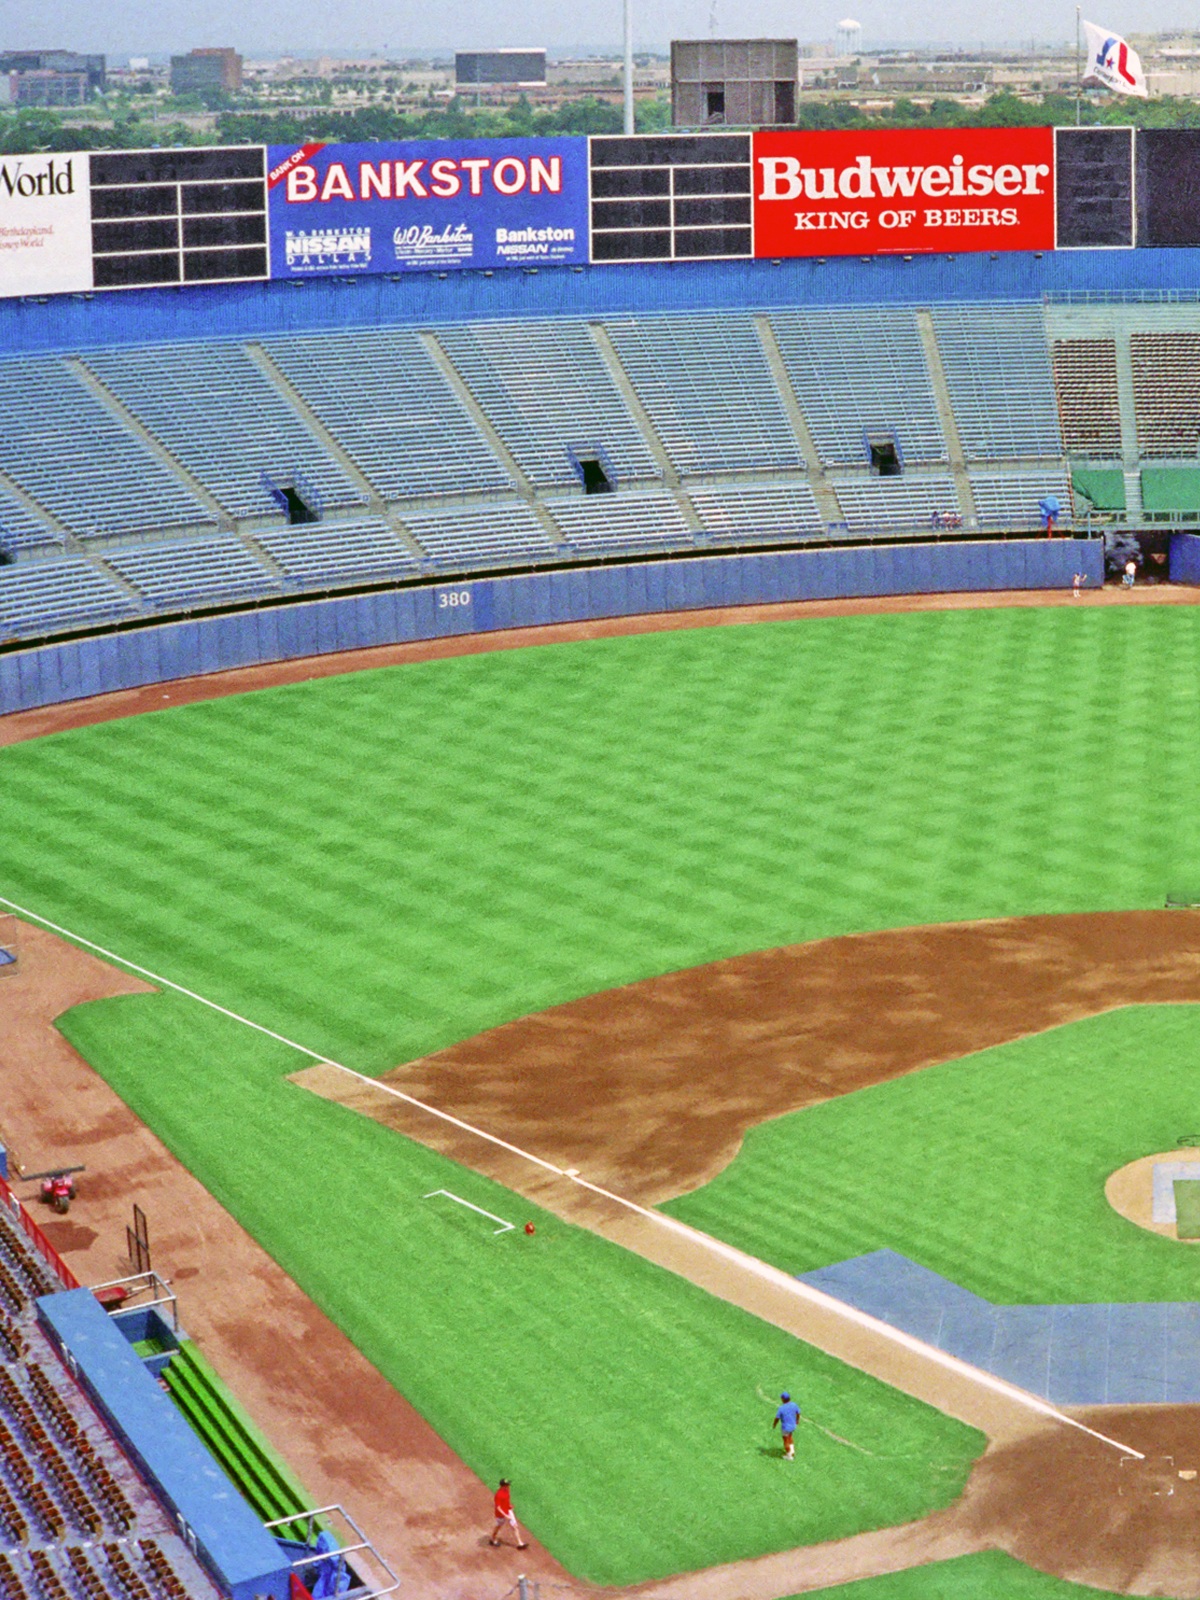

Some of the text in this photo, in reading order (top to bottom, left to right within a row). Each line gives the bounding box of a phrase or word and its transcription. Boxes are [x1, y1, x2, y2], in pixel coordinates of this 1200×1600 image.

[269, 149, 306, 181] BANK ON
[287, 156, 561, 202] BANKSTON
[758, 154, 1050, 201] Budweiser
[794, 211, 870, 231] KING
[878, 209, 917, 229] OF
[496, 226, 575, 243] Bankston
[286, 235, 371, 254] NISSAN
[496, 243, 549, 255] NISSAN
[286, 251, 372, 266] DALLAS
[439, 590, 470, 608] 380
